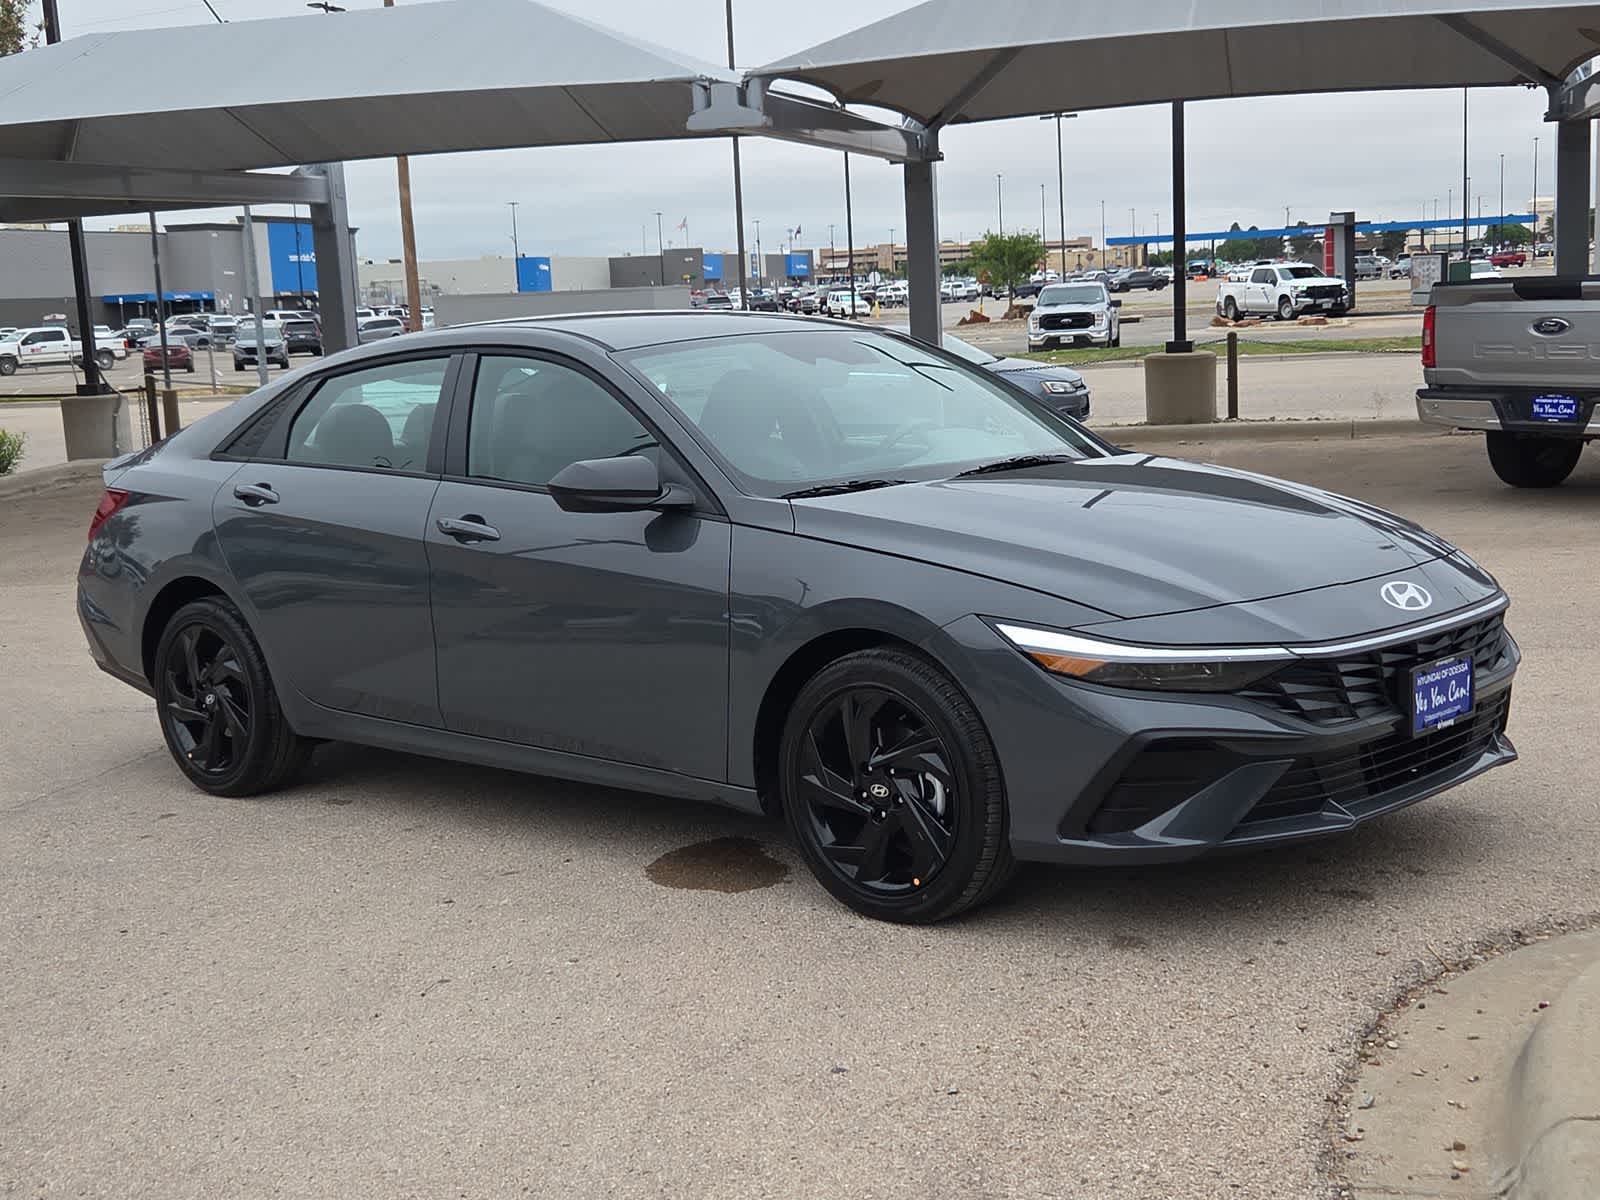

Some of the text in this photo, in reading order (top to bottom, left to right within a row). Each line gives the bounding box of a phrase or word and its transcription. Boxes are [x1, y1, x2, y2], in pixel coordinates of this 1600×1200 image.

[1415, 691, 1428, 714] Yes
[1431, 685, 1446, 709] You
[1448, 674, 1470, 702] Can!
